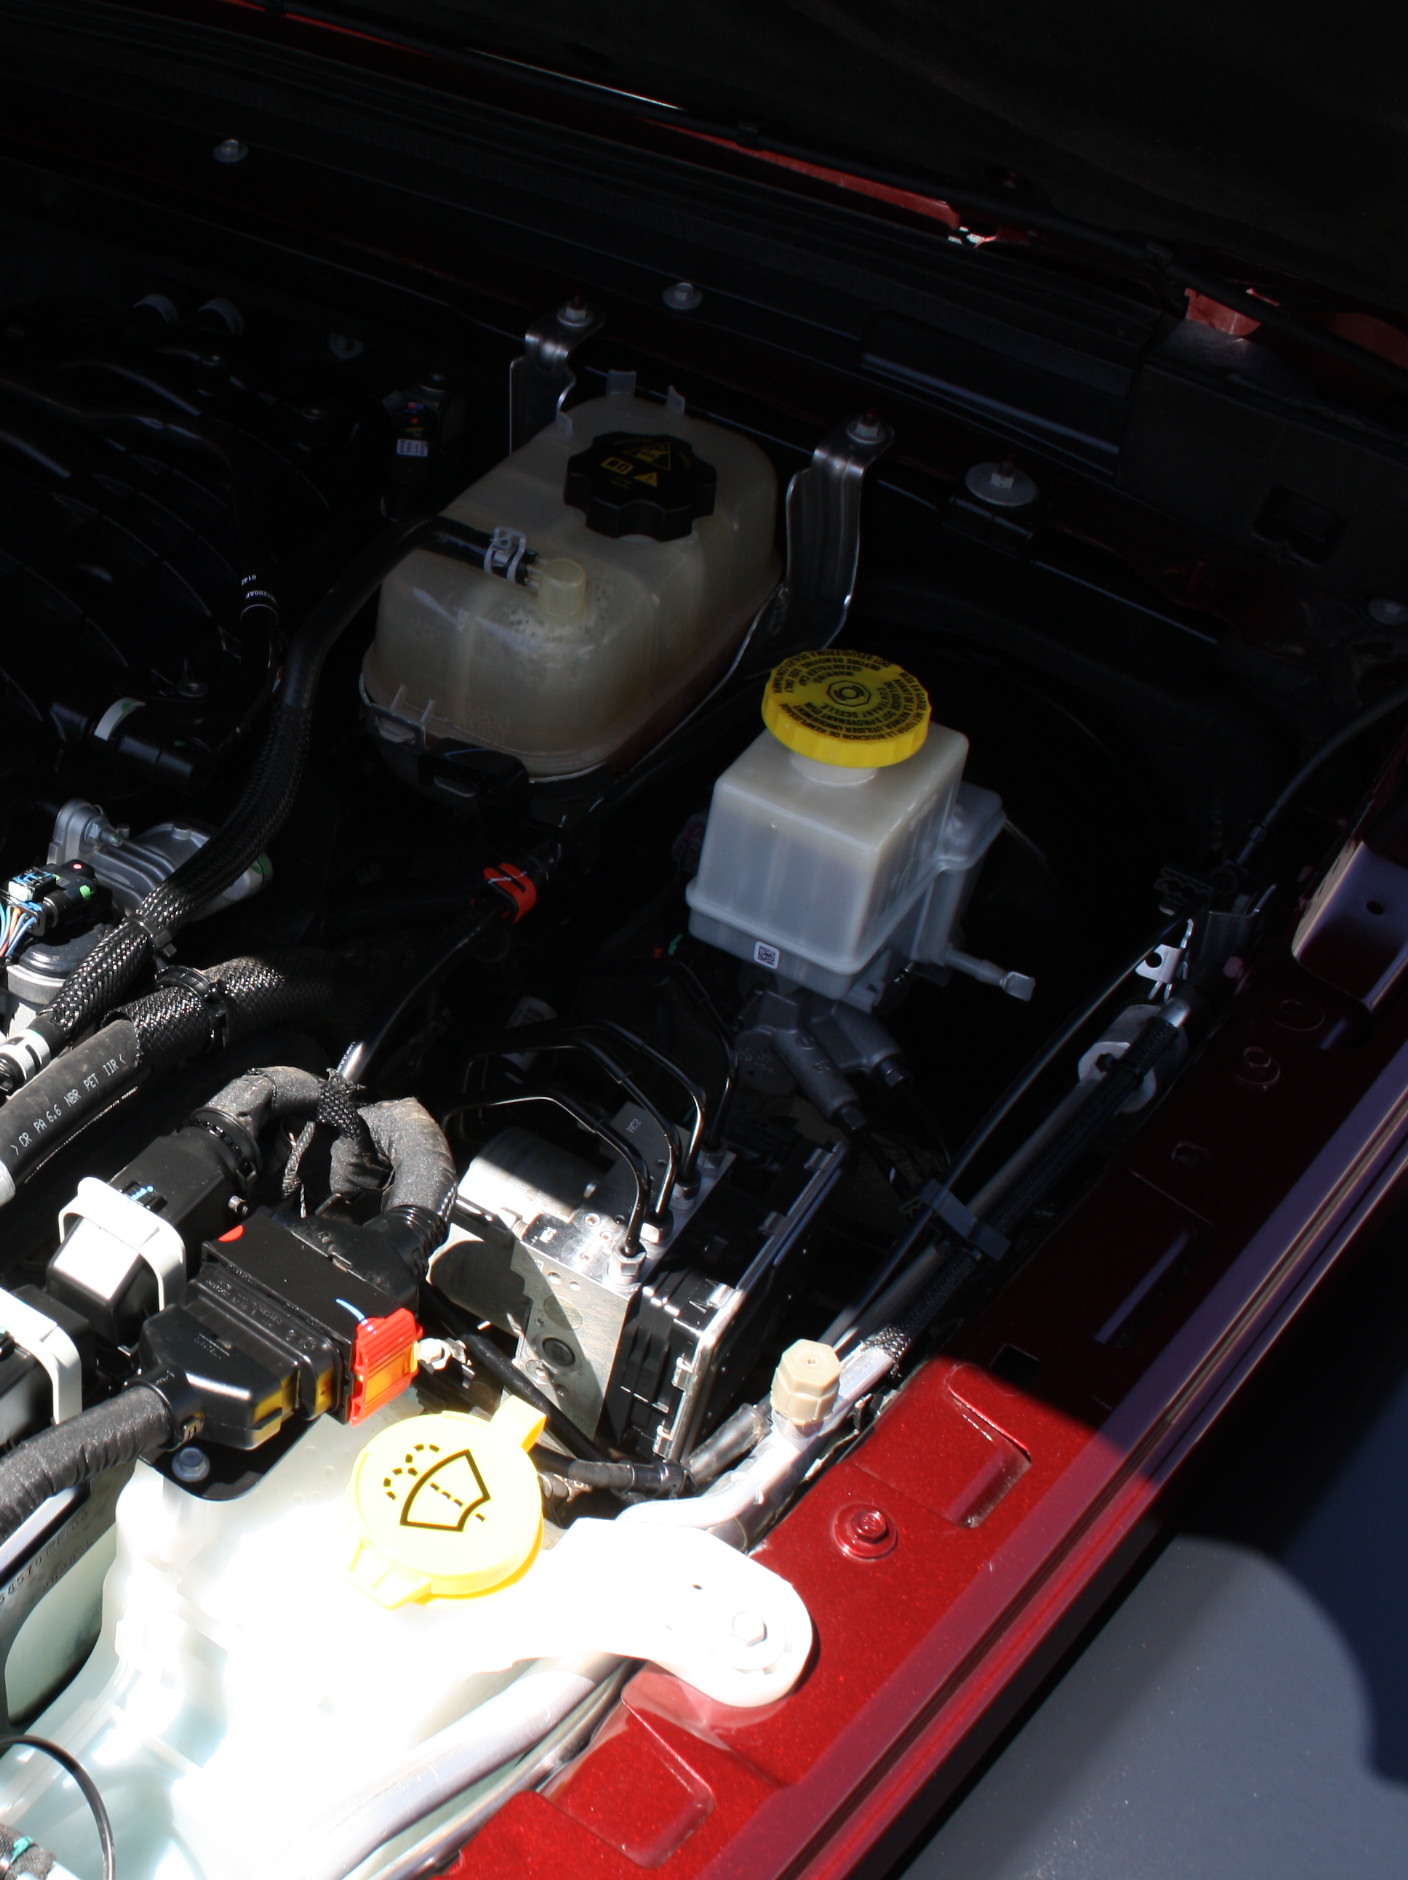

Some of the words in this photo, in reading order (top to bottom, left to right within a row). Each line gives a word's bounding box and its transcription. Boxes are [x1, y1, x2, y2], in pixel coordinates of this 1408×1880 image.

[832, 664, 862, 672] CLEAN
[847, 658, 881, 672] BEFORE
[873, 657, 892, 668] DOT
[788, 667, 804, 679] USE
[805, 665, 833, 676] FILLER
[785, 678, 796, 692] ONLY
[797, 674, 811, 686] CAP
[891, 678, 912, 695] AVANT
[909, 684, 923, 692] EN
[903, 696, 914, 704] DE
[902, 704, 914, 712] LE
[777, 702, 827, 734] REMPLISSAGE
[792, 704, 842, 731] UNIQUEMENT
[819, 711, 877, 725] PROVENANT
[879, 710, 897, 721] DOT
[894, 711, 925, 735] NETTOYER
[828, 730, 840, 738] DE
[844, 725, 884, 733] UTILISER
[884, 730, 898, 738] LE
[18, 1132, 32, 1147] CR
[33, 1119, 47, 1133] PA
[64, 1089, 81, 1107] NBR
[83, 1073, 99, 1091] PET
